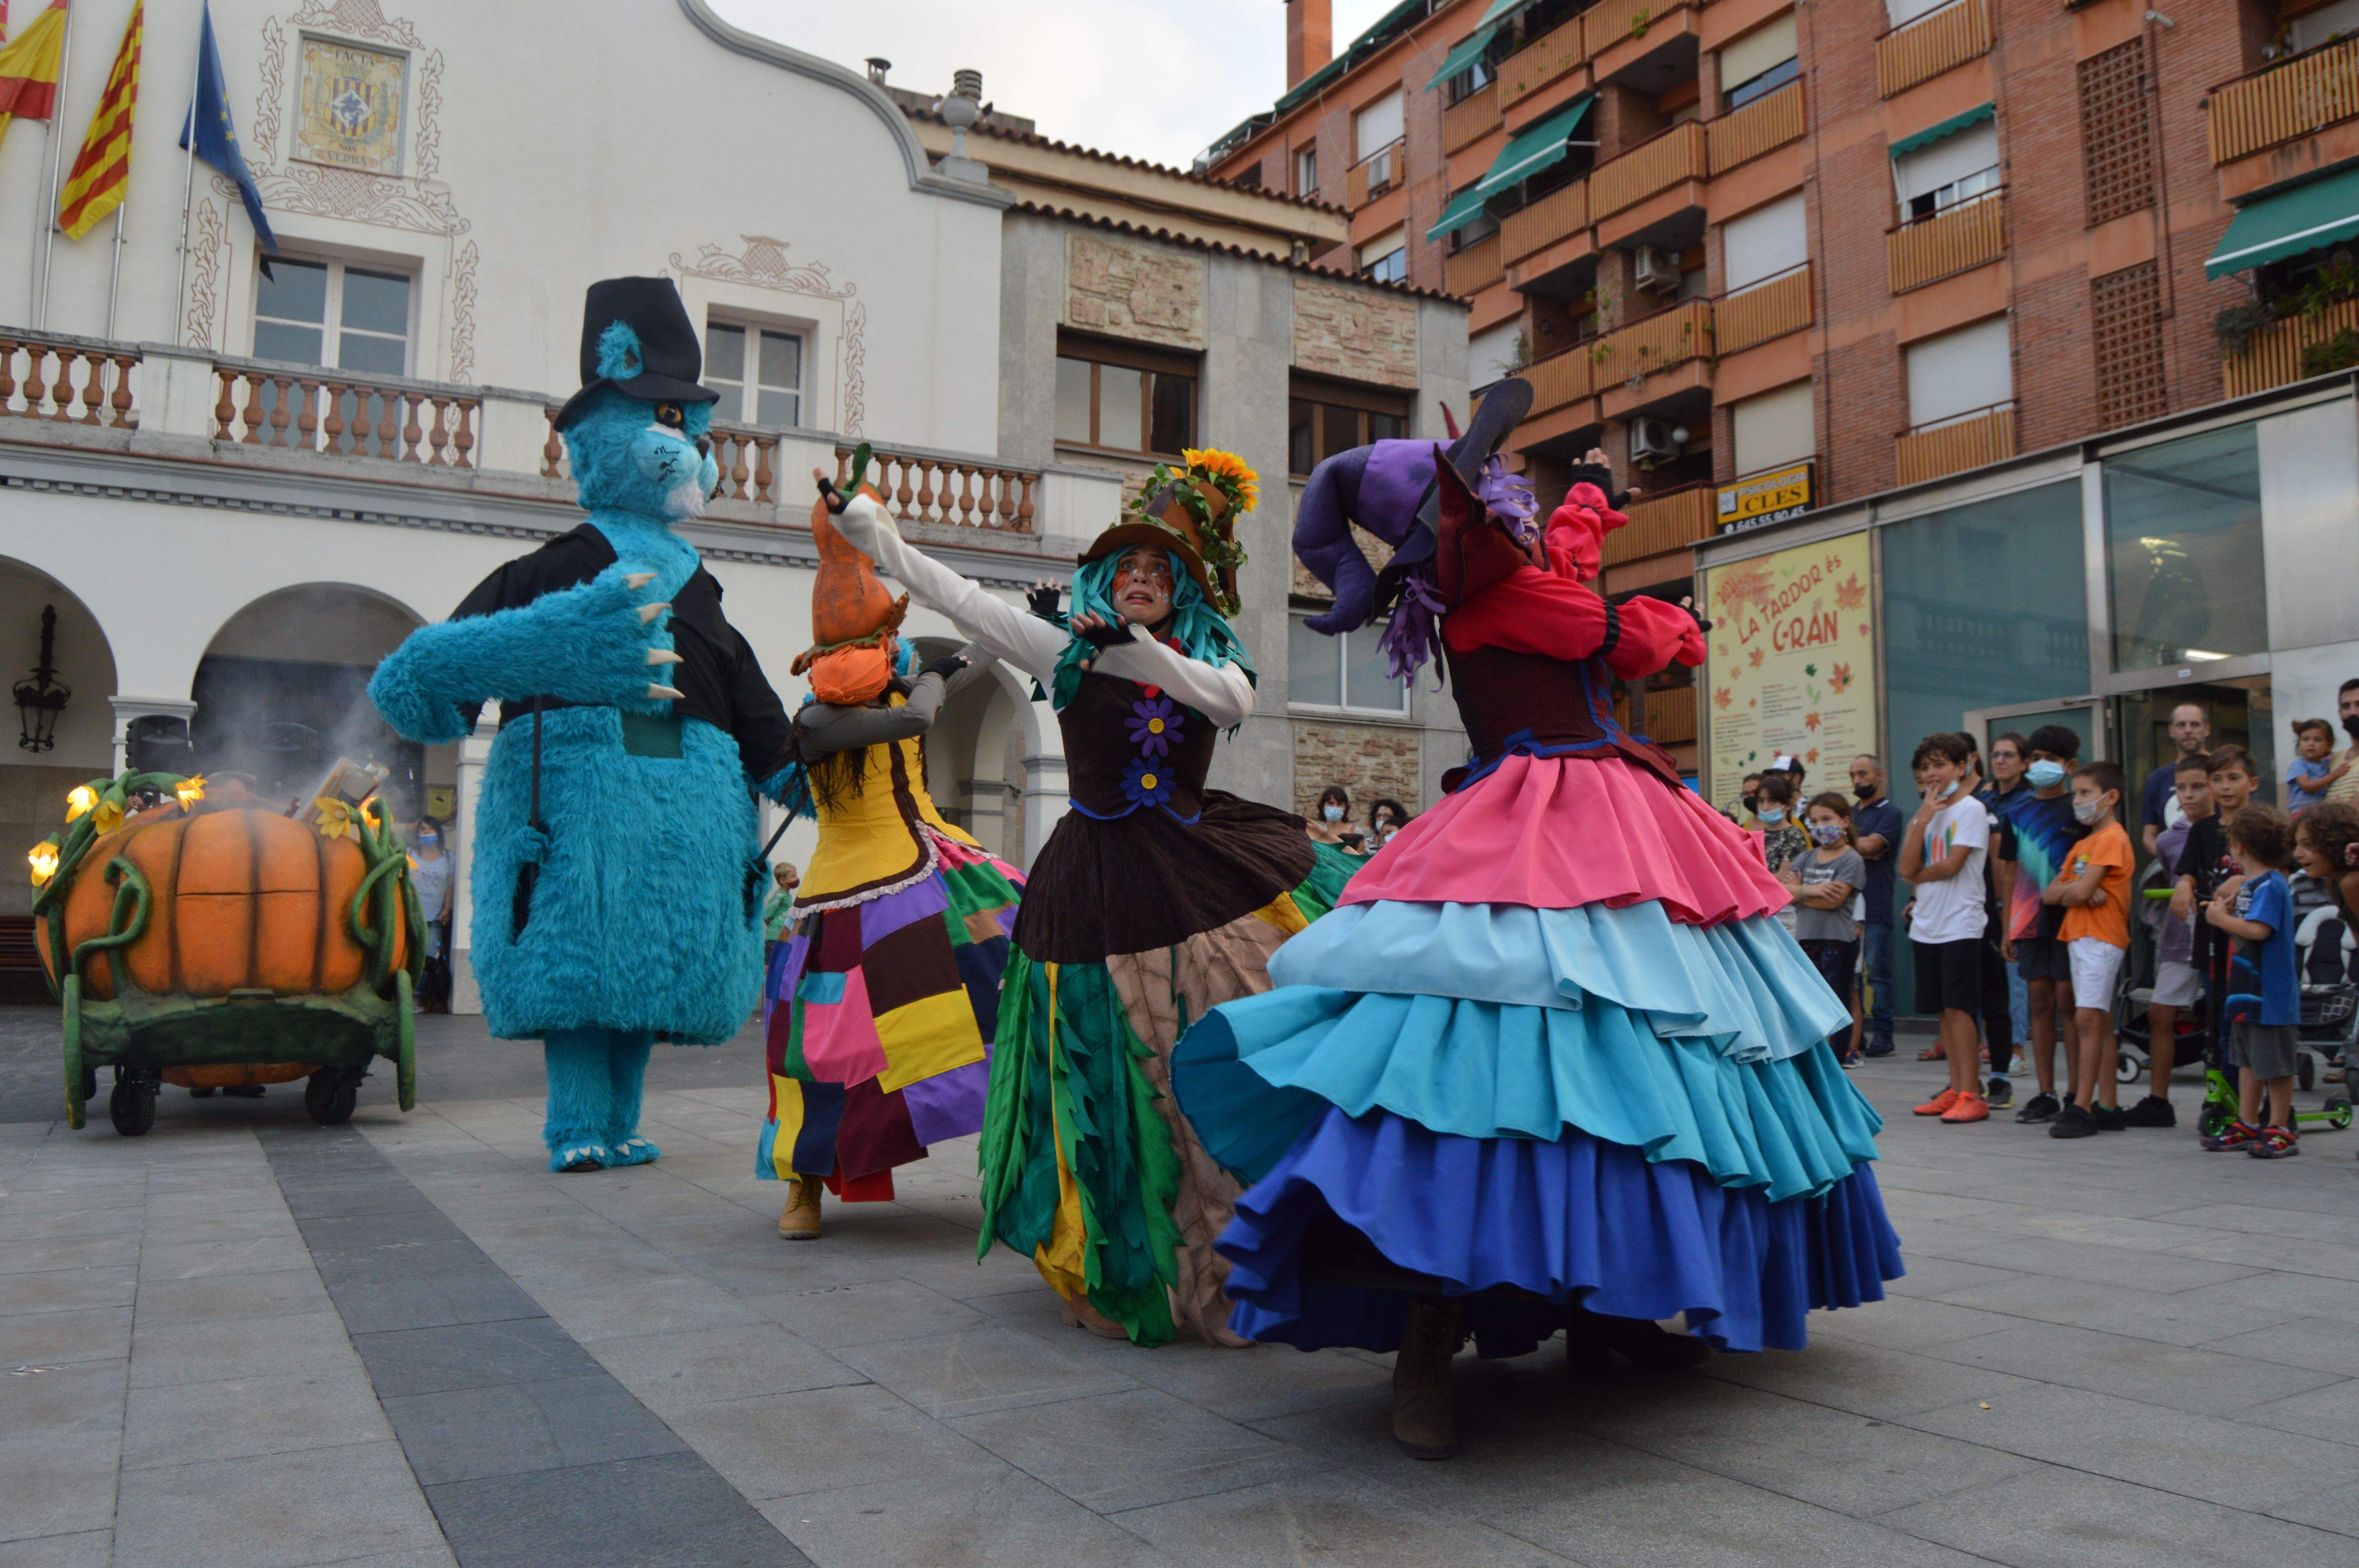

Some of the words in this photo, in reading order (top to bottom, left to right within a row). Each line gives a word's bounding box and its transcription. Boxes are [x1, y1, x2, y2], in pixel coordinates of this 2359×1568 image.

[334, 49, 374, 66] FACTA
[339, 143, 357, 152] NON
[1745, 485, 1801, 512] CLES
[1738, 617, 1760, 645] LA
[1760, 564, 1823, 624] TARDOR
[1773, 610, 1839, 652] GRAN
